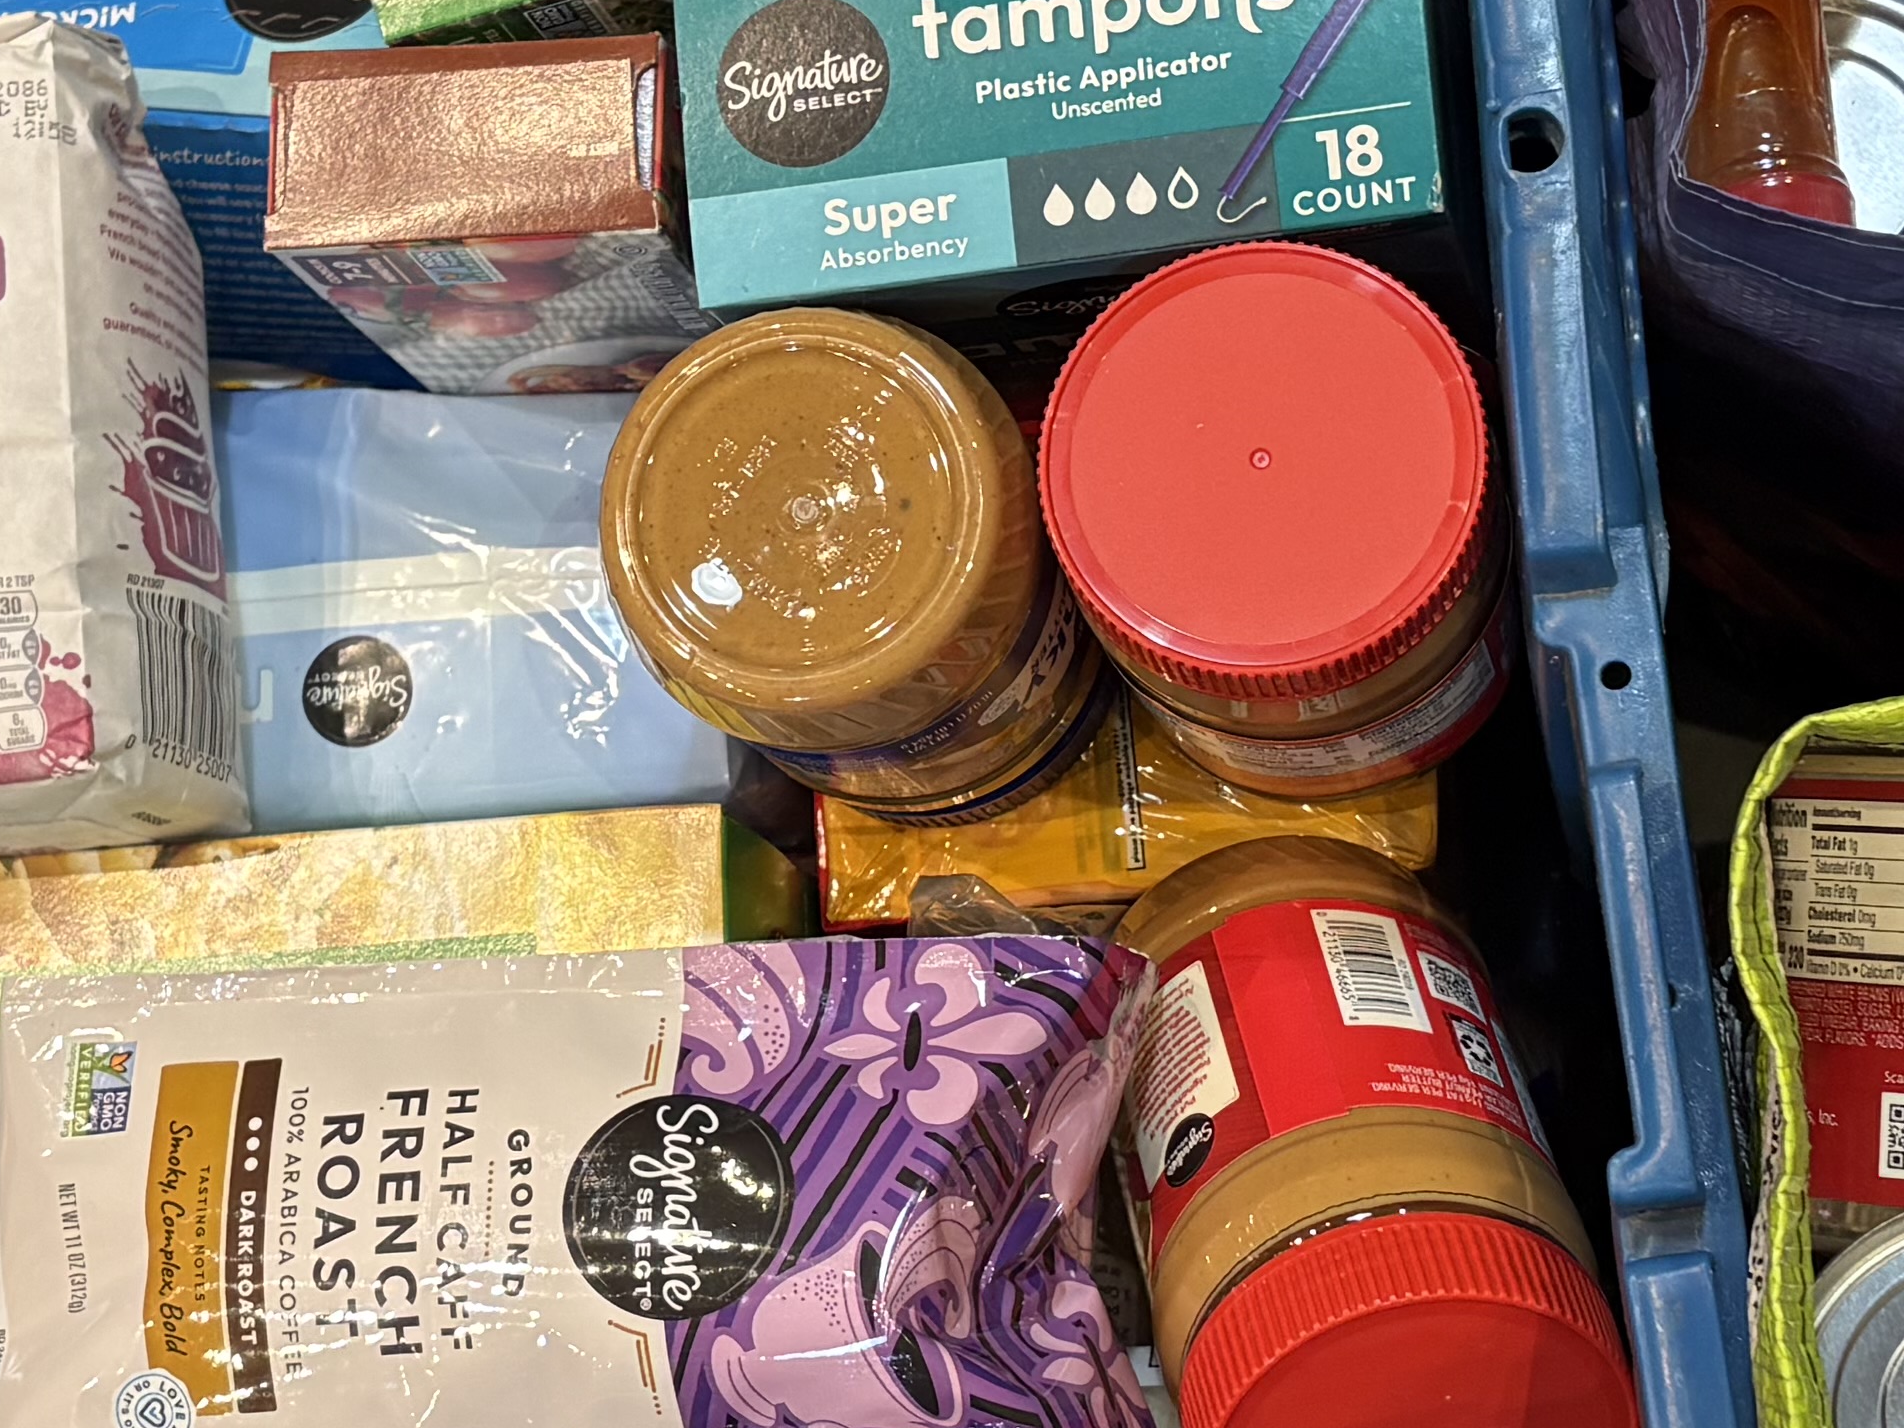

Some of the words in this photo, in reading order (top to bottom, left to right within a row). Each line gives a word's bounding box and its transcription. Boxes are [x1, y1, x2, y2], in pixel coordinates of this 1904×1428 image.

[722, 51, 884, 123] Signature
[791, 86, 883, 115] SELECT
[975, 70, 1074, 106] Plastic
[1078, 47, 1233, 92] Applicator
[1050, 87, 1163, 123] Unscented
[1313, 123, 1386, 179] 18
[821, 188, 958, 240] Super
[1291, 175, 1418, 217] COUNT
[819, 233, 970, 273] Absorbency
[0, 596, 22, 616] 30
[99, 1092, 115, 1130] GMO
[112, 1092, 128, 1130] NON
[286, 1086, 311, 1144] 100%
[158, 1121, 193, 1195] Smoky,
[438, 1088, 480, 1206] HALF
[236, 1190, 257, 1256] DARK
[278, 1152, 302, 1266] ARABICA
[312, 1112, 366, 1339] ROAST
[374, 1088, 430, 1356] FRENCH
[502, 1128, 534, 1298] GROUND
[629, 1102, 720, 1311] Signature
[159, 1202, 186, 1297] Complex,
[159, 1303, 188, 1356] Bold
[237, 1263, 258, 1344] ROAST
